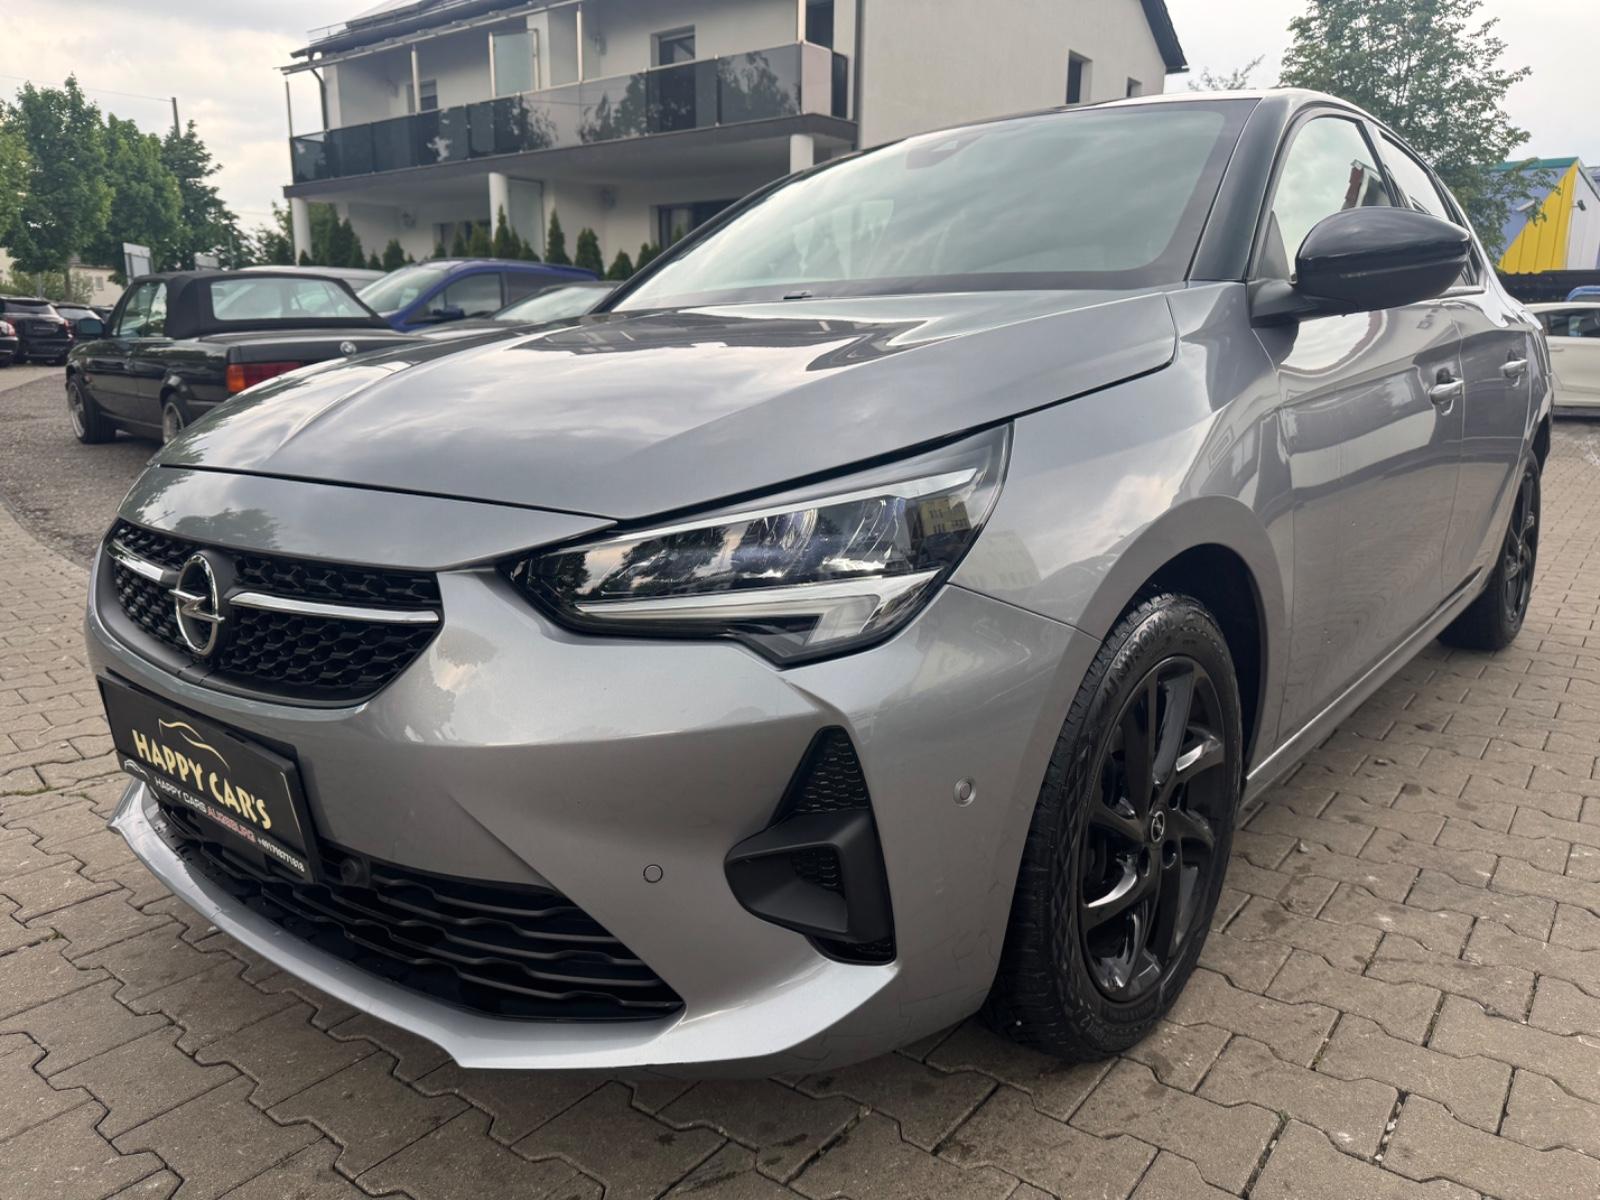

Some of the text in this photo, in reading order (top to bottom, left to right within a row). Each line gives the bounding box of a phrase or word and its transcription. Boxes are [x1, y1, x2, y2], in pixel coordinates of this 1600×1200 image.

[131, 729, 272, 830] HAPPY CAR'S
[155, 775, 182, 799] HAPPY
